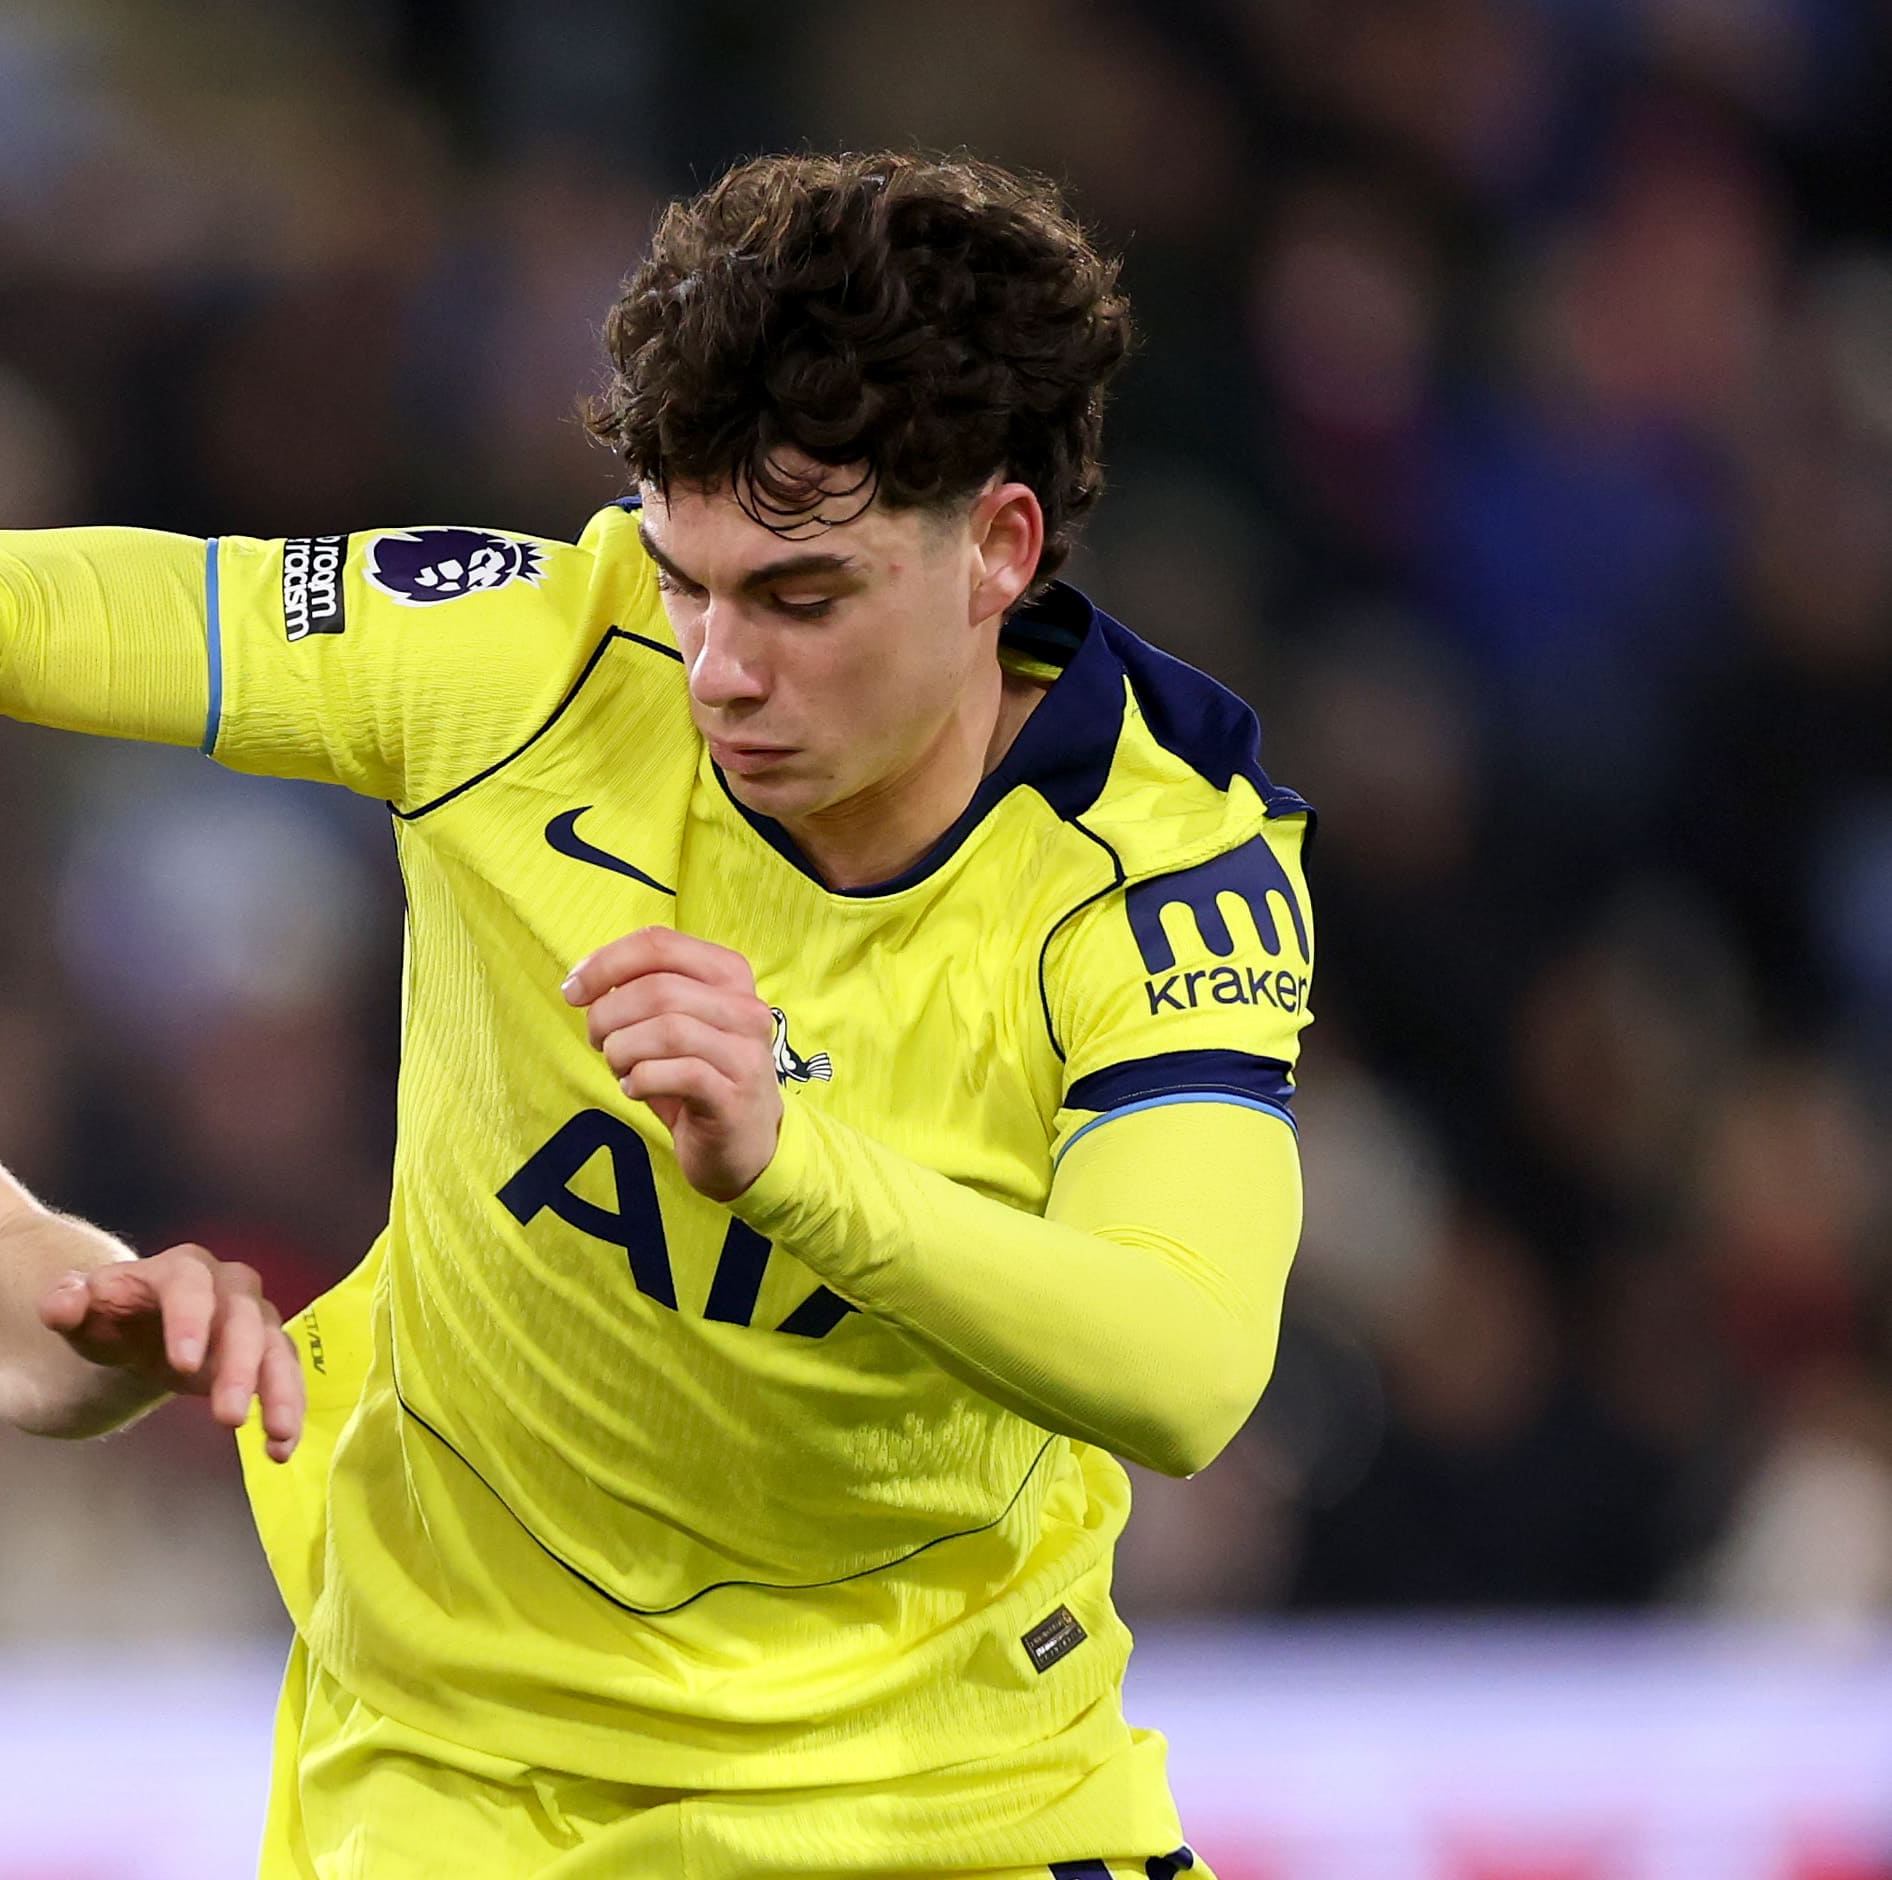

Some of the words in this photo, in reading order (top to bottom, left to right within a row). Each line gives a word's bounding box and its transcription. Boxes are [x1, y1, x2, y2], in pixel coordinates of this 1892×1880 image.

[284, 545, 310, 641] racism
[308, 546, 339, 618] room
[495, 1108, 862, 1339] AI
